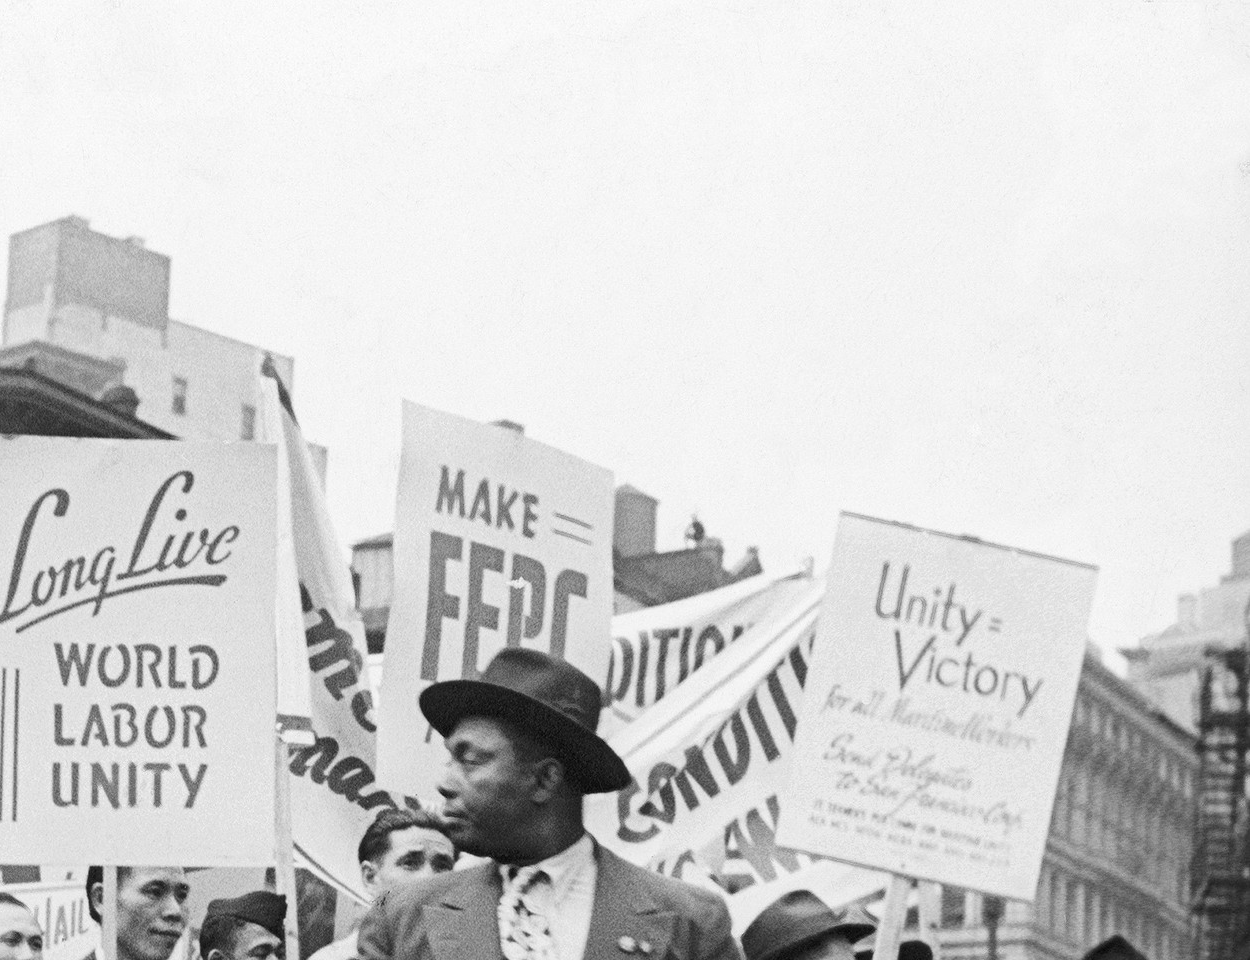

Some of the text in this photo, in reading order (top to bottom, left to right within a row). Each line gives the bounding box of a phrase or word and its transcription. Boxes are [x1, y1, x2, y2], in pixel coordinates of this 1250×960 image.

[117, 470, 240, 581] Live
[435, 465, 540, 538] MAKE
[875, 561, 983, 646] Unity
[53, 642, 220, 690] WORLD
[895, 629, 1044, 719] Victory
[53, 703, 209, 748] LABOR
[52, 763, 209, 809] UNITY
